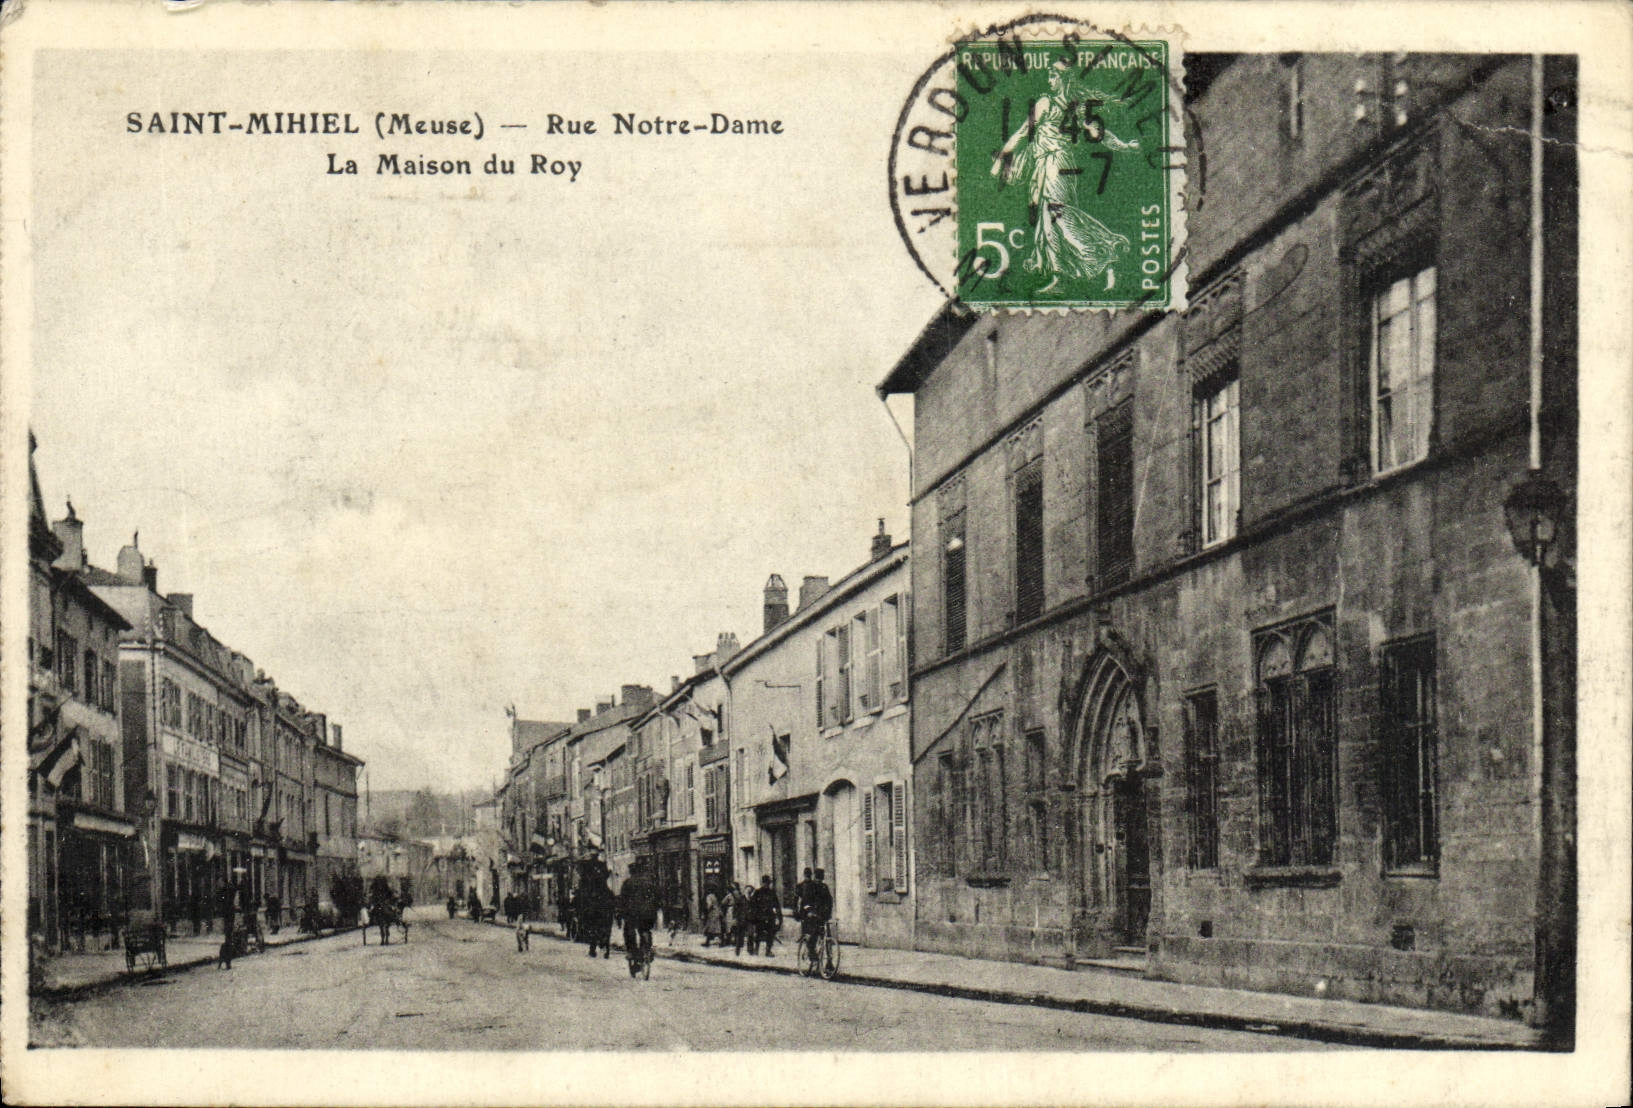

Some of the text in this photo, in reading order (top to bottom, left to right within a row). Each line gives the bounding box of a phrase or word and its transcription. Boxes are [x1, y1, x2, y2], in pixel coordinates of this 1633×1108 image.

[961, 51, 1160, 72] RPULQUE FRANÇAISE
[902, 34, 1028, 234] VERDUN
[1059, 98, 1106, 143] 45
[1140, 203, 1160, 290] POSTES
